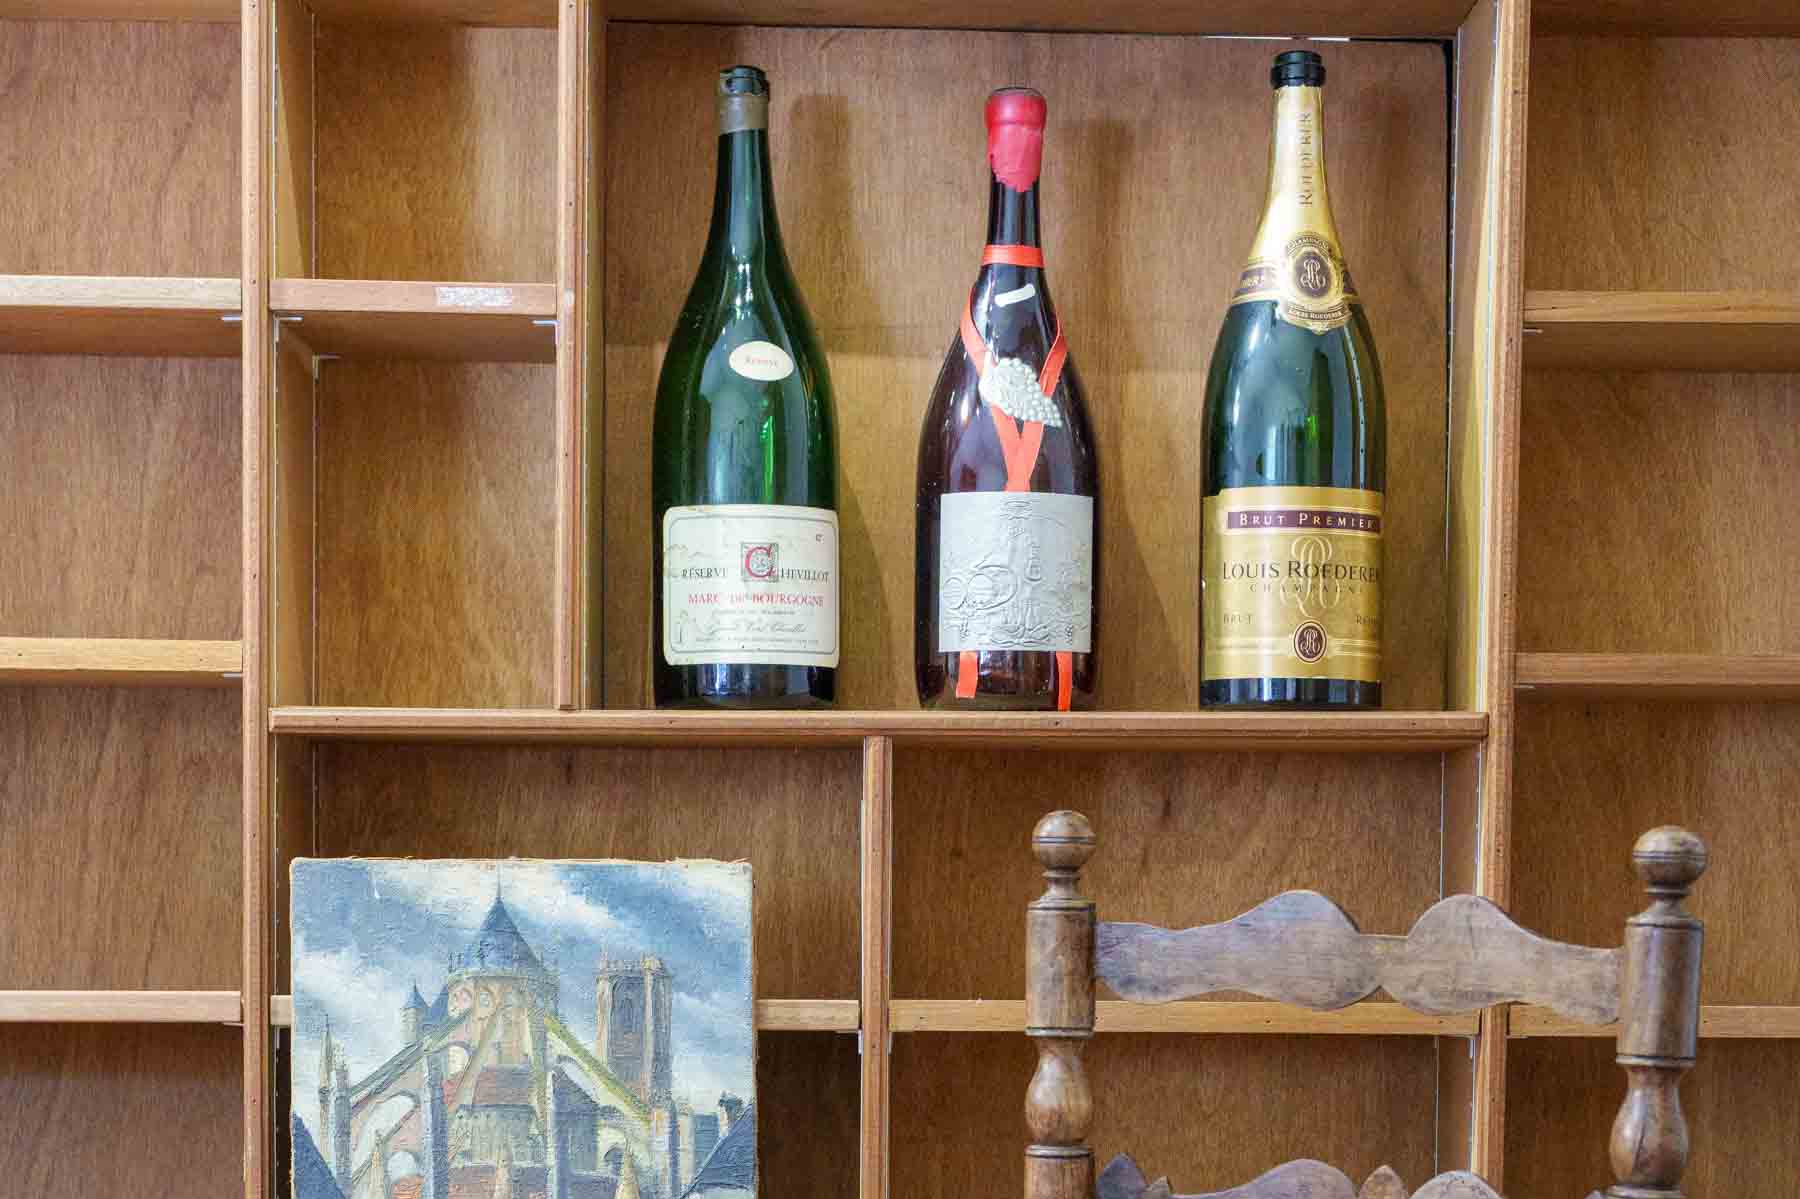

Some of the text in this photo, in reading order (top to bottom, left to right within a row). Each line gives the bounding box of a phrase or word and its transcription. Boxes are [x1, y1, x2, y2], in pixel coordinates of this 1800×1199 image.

[1239, 513, 1375, 529] BRUT PREMIER
[1223, 560, 1280, 580] LOUIS
[688, 593, 720, 605] MARC
[752, 593, 824, 607] BOURGOGNE
